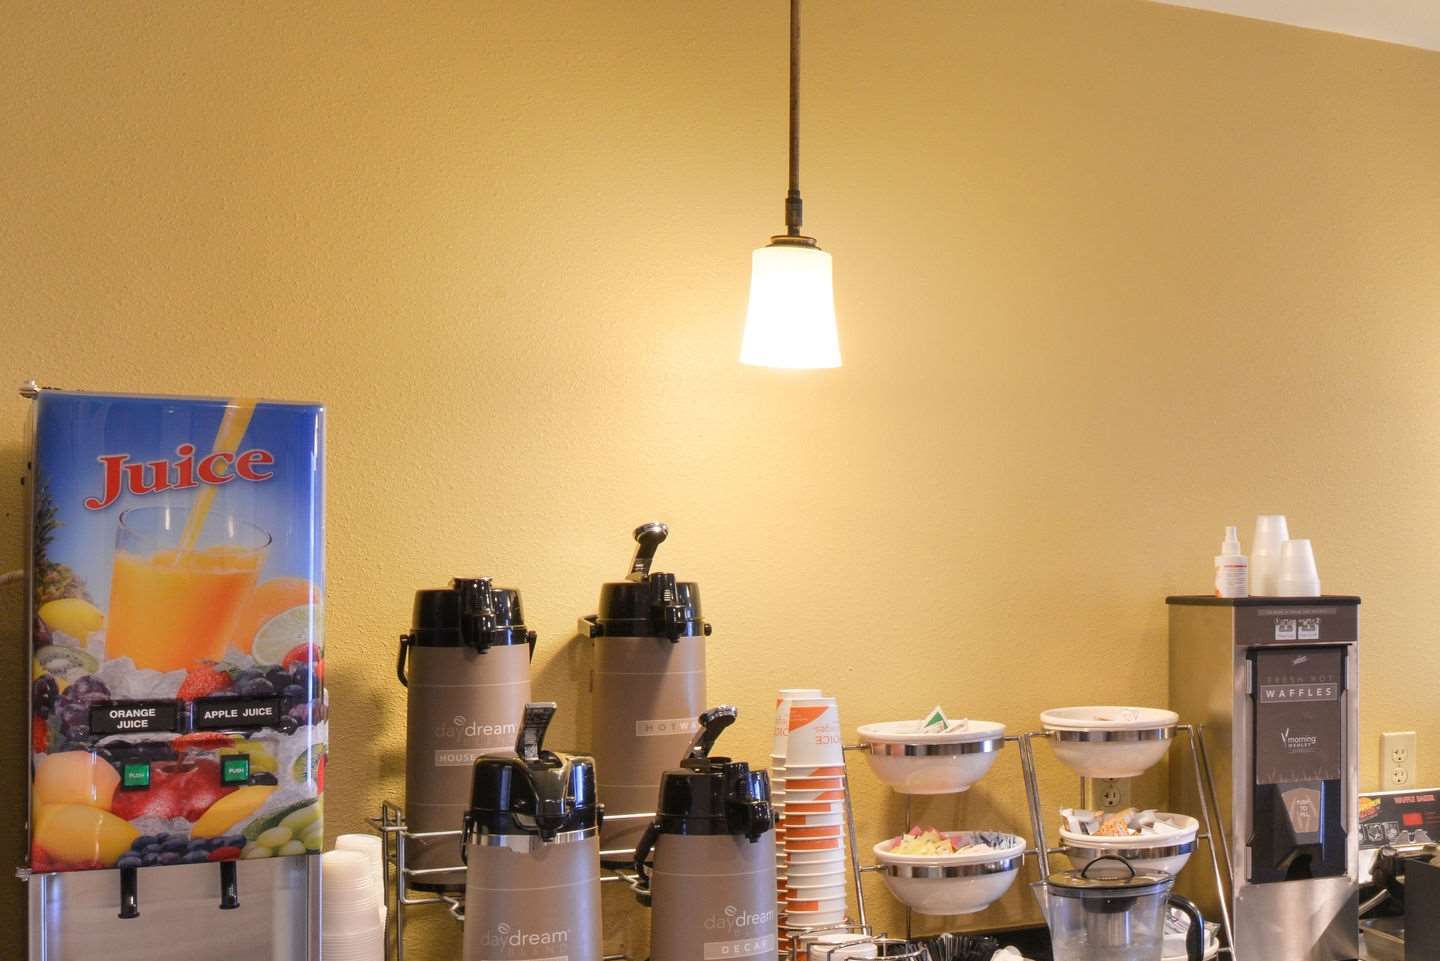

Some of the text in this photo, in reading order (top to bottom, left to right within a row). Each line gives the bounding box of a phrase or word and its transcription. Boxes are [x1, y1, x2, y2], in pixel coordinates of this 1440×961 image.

[84, 443, 275, 511] Juice
[1265, 687, 1332, 698] WAFFLES
[109, 708, 156, 719] ORANGE
[204, 707, 273, 719] APPLE JUICE
[116, 719, 149, 729] JUICE
[434, 720, 516, 739] daydream
[703, 911, 774, 931] daydream
[481, 929, 568, 952] daydream
[721, 941, 768, 955] DECAF
